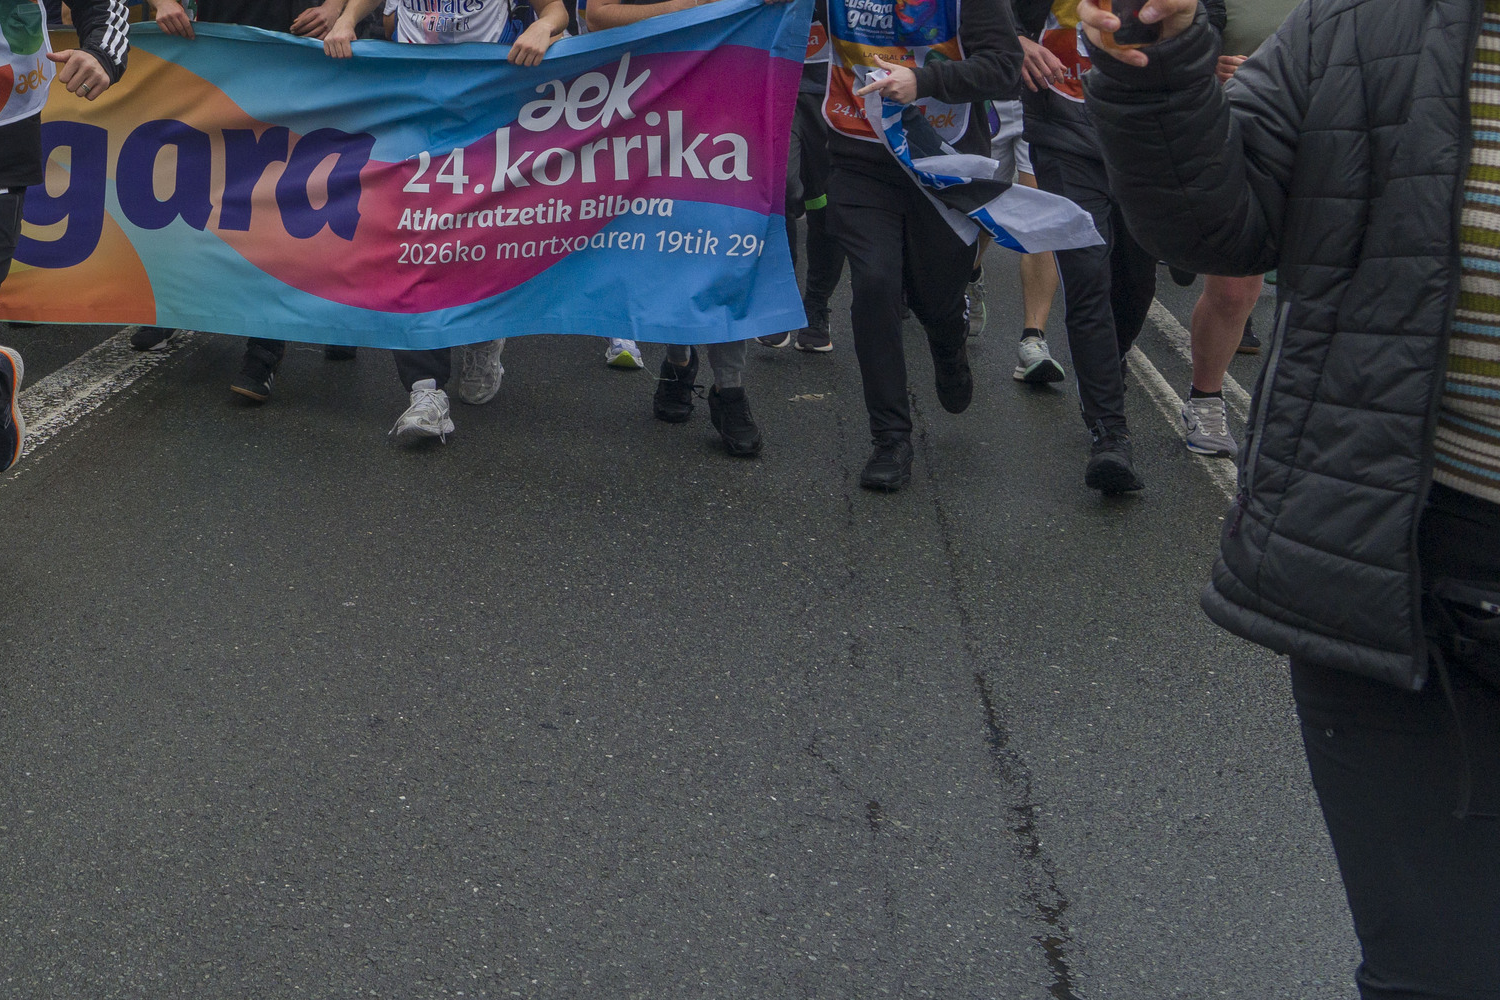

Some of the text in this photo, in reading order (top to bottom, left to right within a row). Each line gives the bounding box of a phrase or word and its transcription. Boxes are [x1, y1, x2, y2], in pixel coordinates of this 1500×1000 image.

[847, 8, 894, 29] gara
[15, 58, 47, 95] aek
[518, 52, 651, 132] aek
[402, 110, 753, 195] 24.korrika
[13, 118, 377, 269] gara
[397, 194, 674, 231] Atharratzetik Bilbora
[397, 240, 486, 265] 2026ko
[496, 230, 646, 260] martxoaren
[656, 228, 719, 256] 19tik
